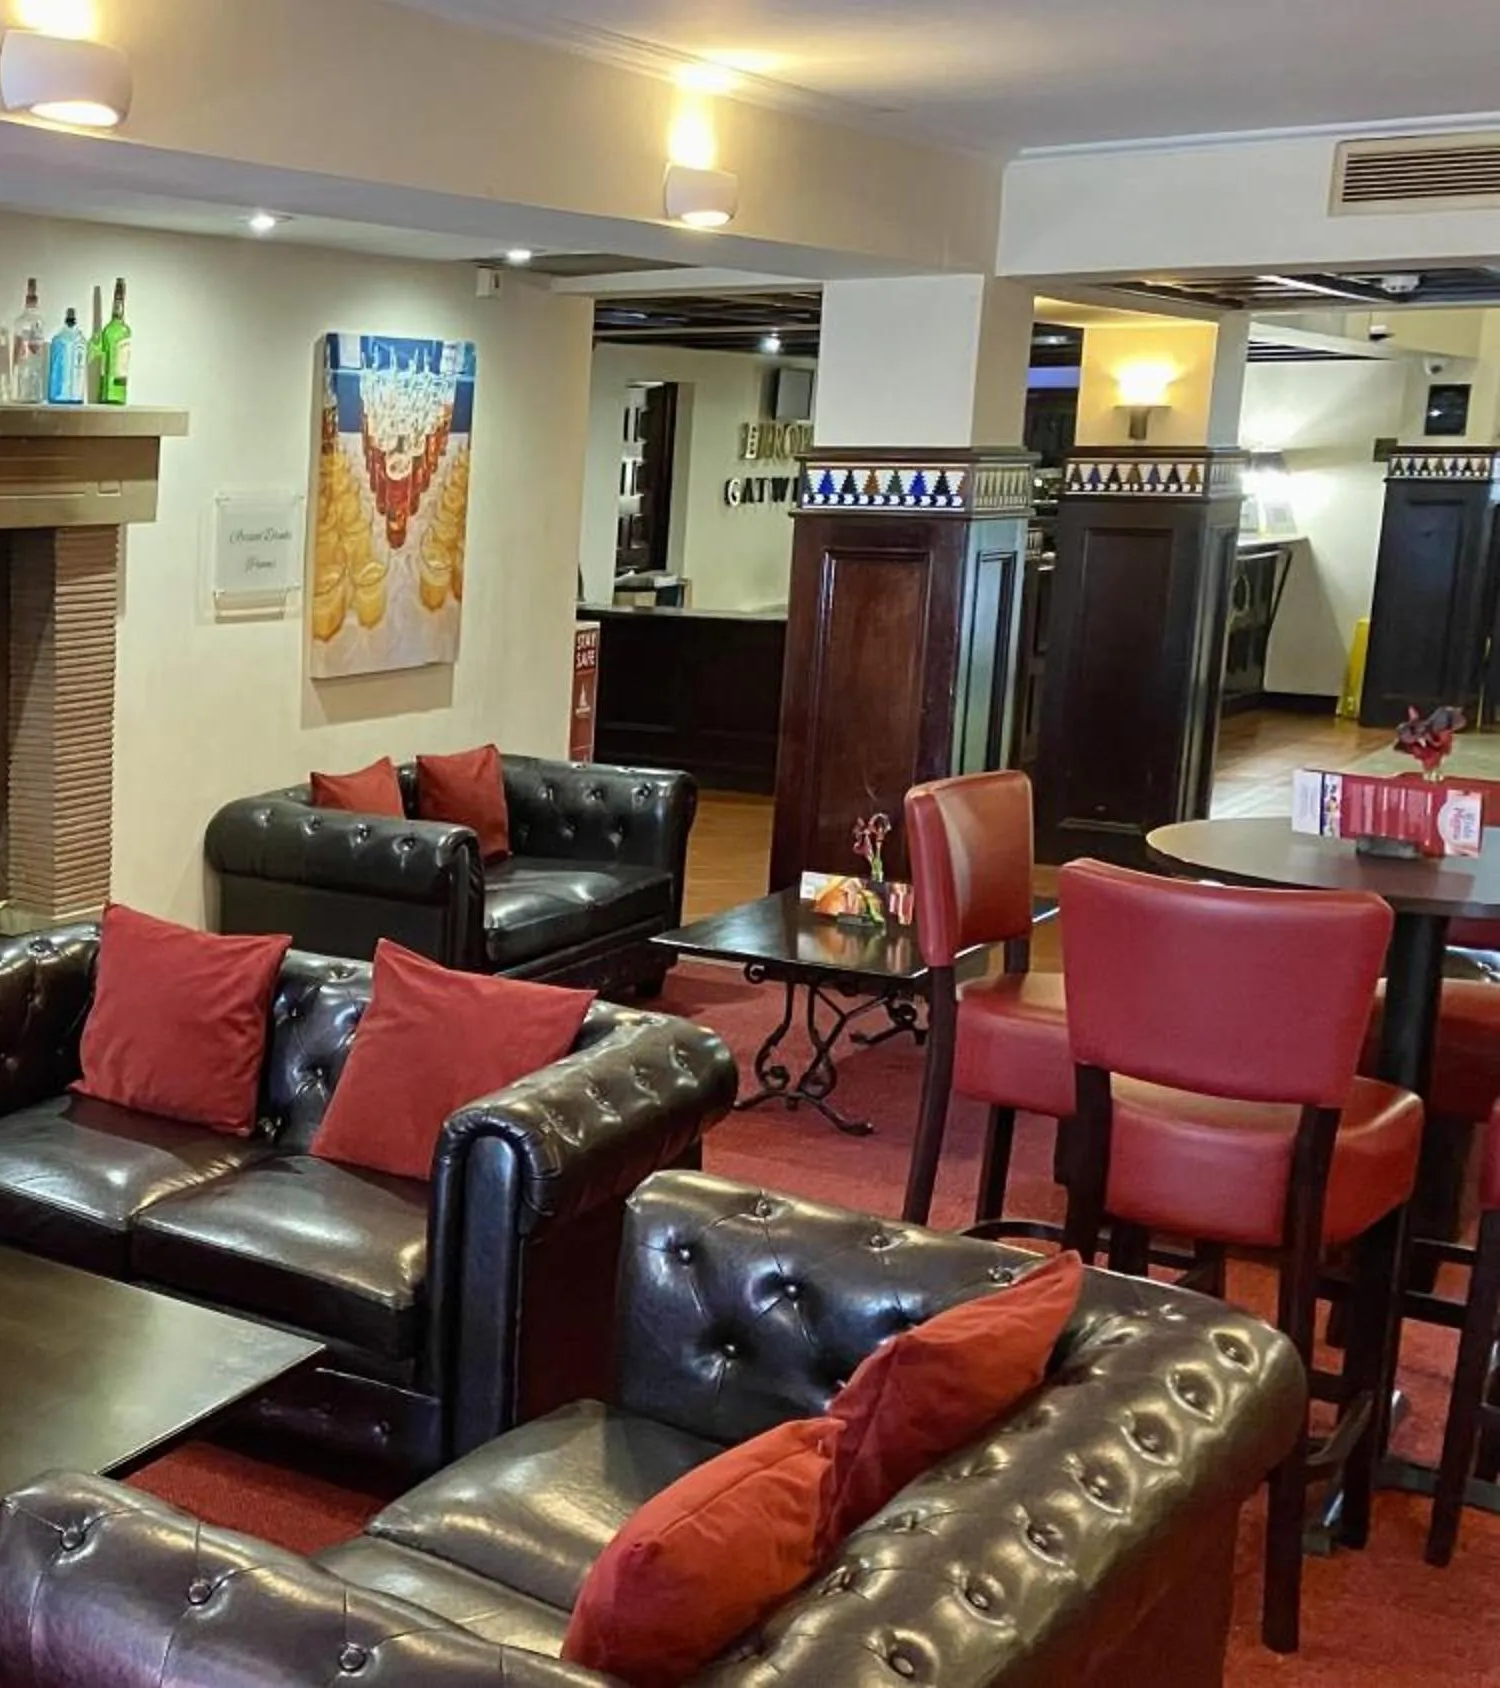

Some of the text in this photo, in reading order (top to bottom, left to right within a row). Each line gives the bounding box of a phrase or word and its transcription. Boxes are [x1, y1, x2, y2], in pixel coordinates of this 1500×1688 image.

[741, 423, 813, 459] EUROP
[724, 478, 799, 506] GATWI
[577, 631, 596, 650] STAY
[576, 650, 595, 668] SAFE
